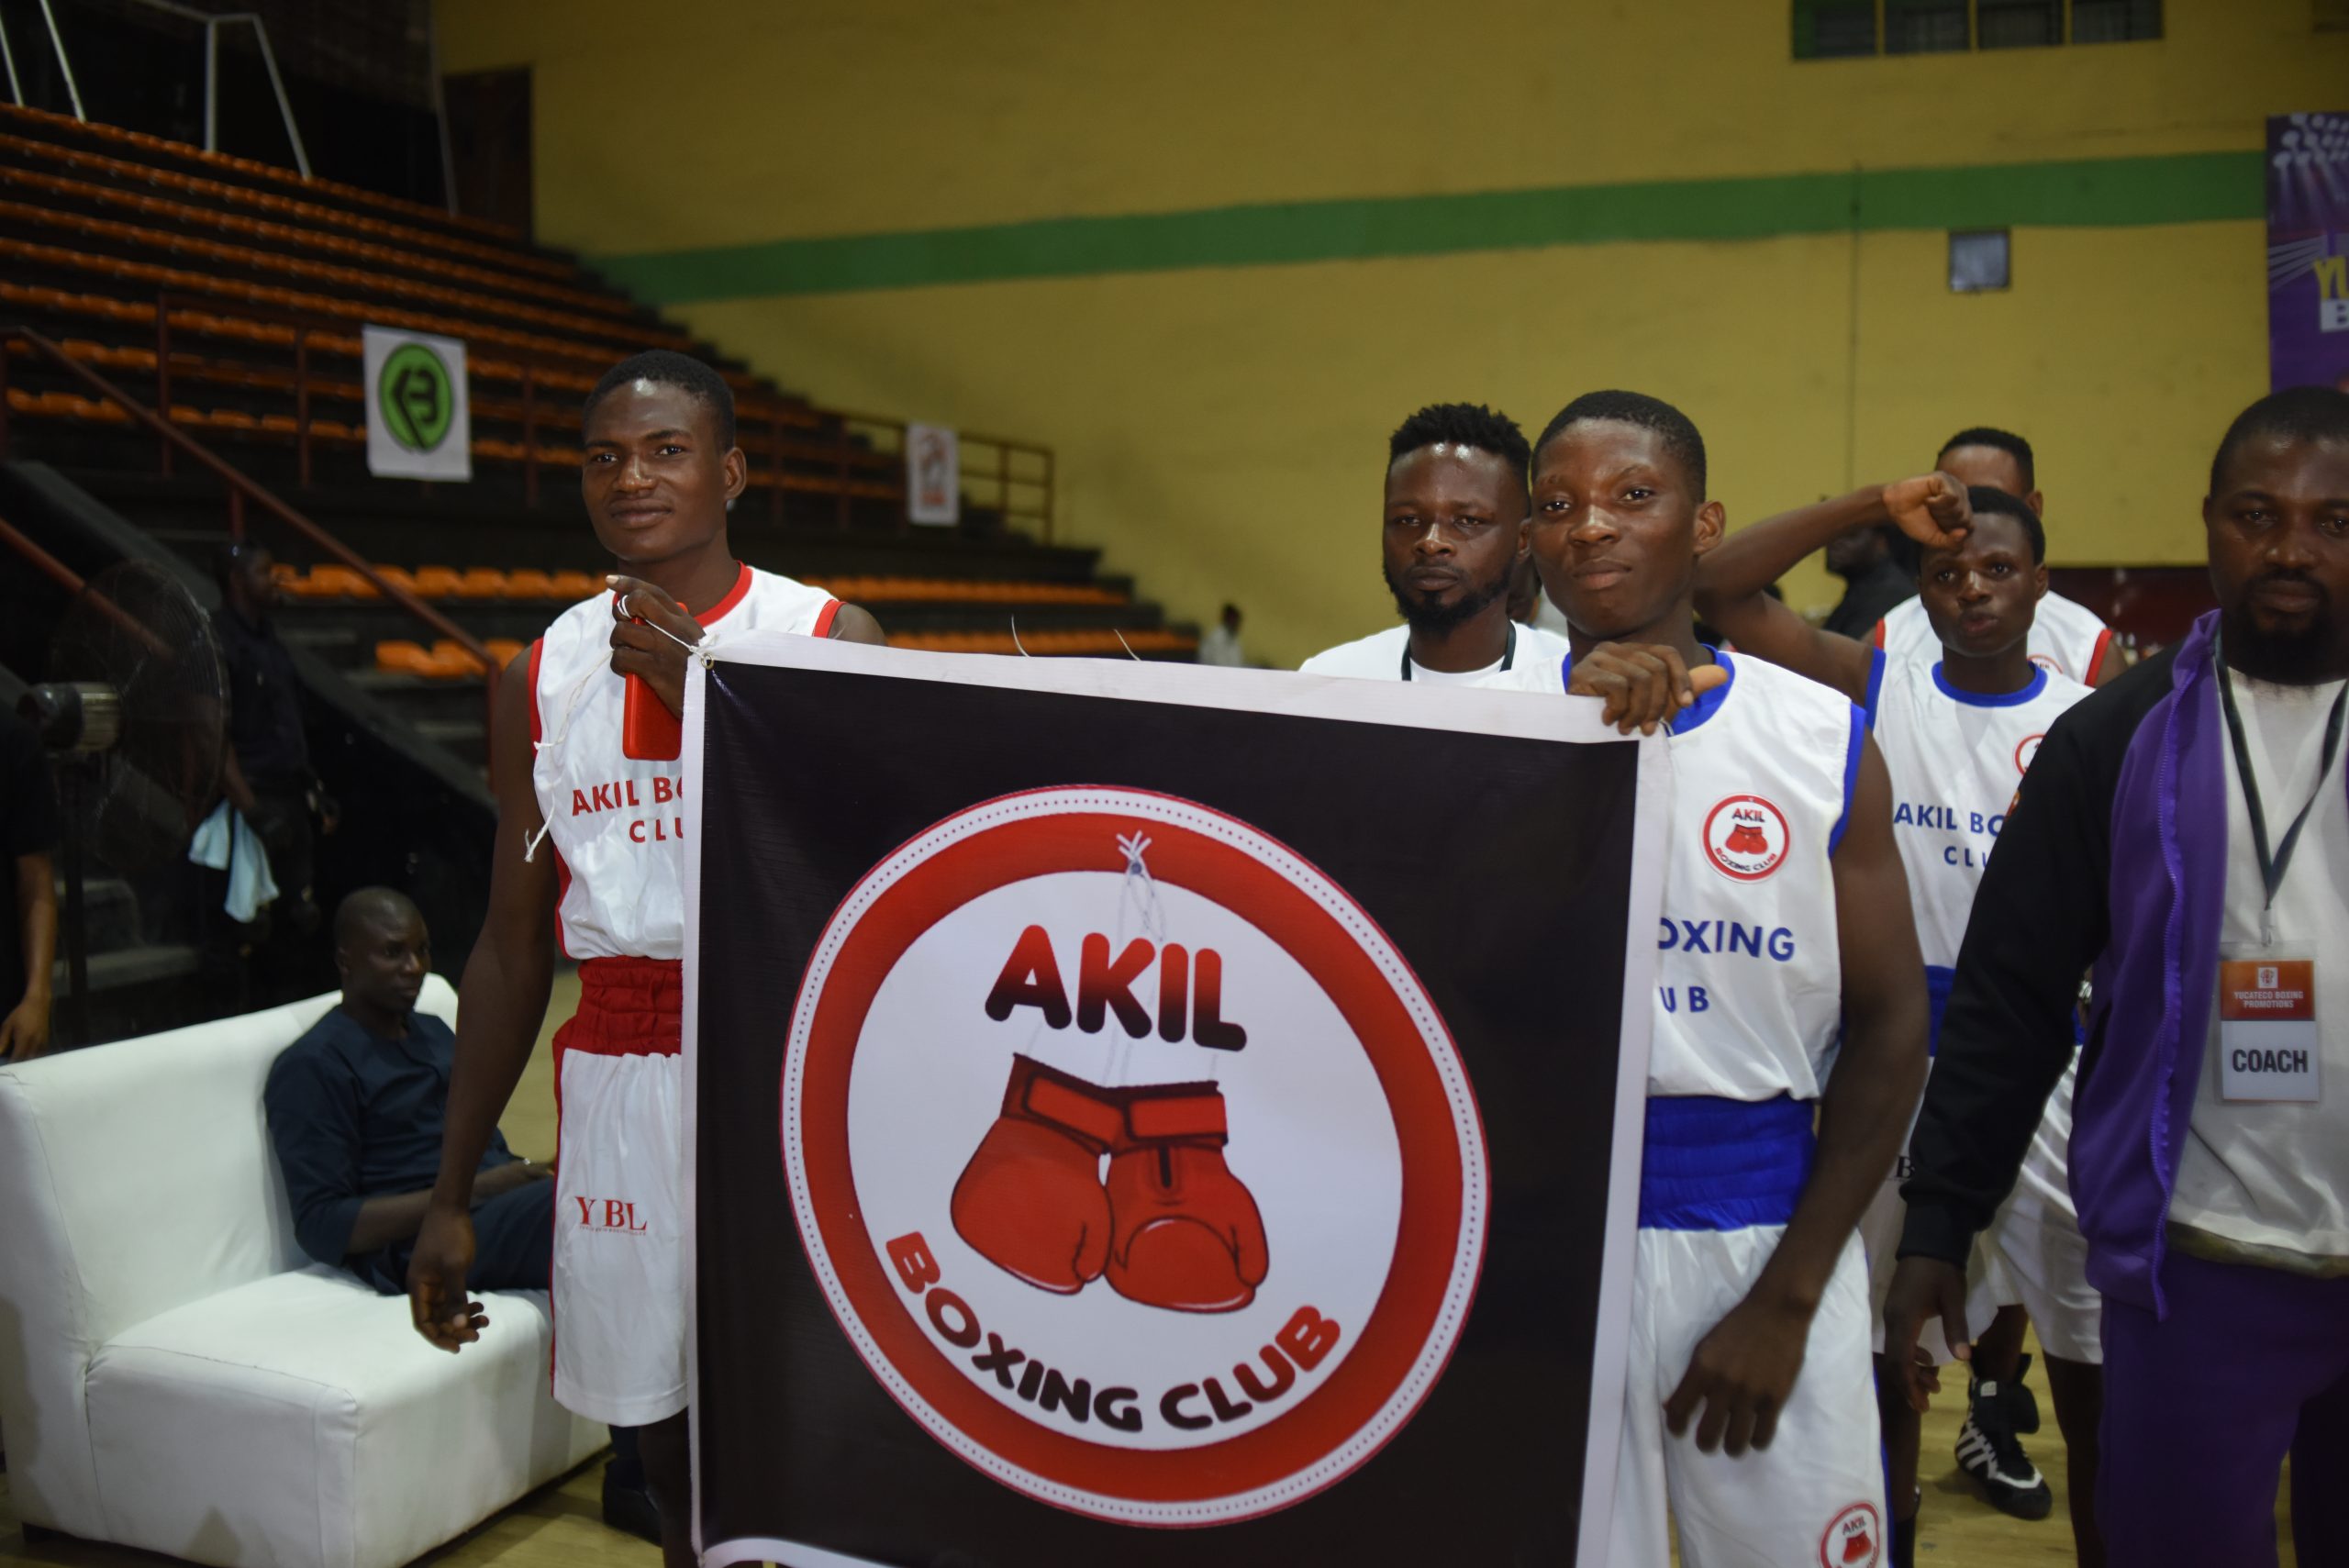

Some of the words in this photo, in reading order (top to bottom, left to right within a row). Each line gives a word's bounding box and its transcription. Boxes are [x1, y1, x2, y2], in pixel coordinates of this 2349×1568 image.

[573, 780, 640, 816] AKIL
[1731, 807, 1765, 822] AKIL
[1894, 802, 1958, 830] AKIL
[985, 924, 1247, 1051] AKIL
[2233, 991, 2273, 1000] YUCATECO
[2275, 991, 2304, 1000] BOXING
[2243, 999, 2294, 1008] PROMOTIONS
[2232, 1049, 2310, 1073] COACH
[574, 1195, 648, 1230] YBL
[886, 1230, 1142, 1433] BOXING
[1160, 1306, 1341, 1430] CLUB
